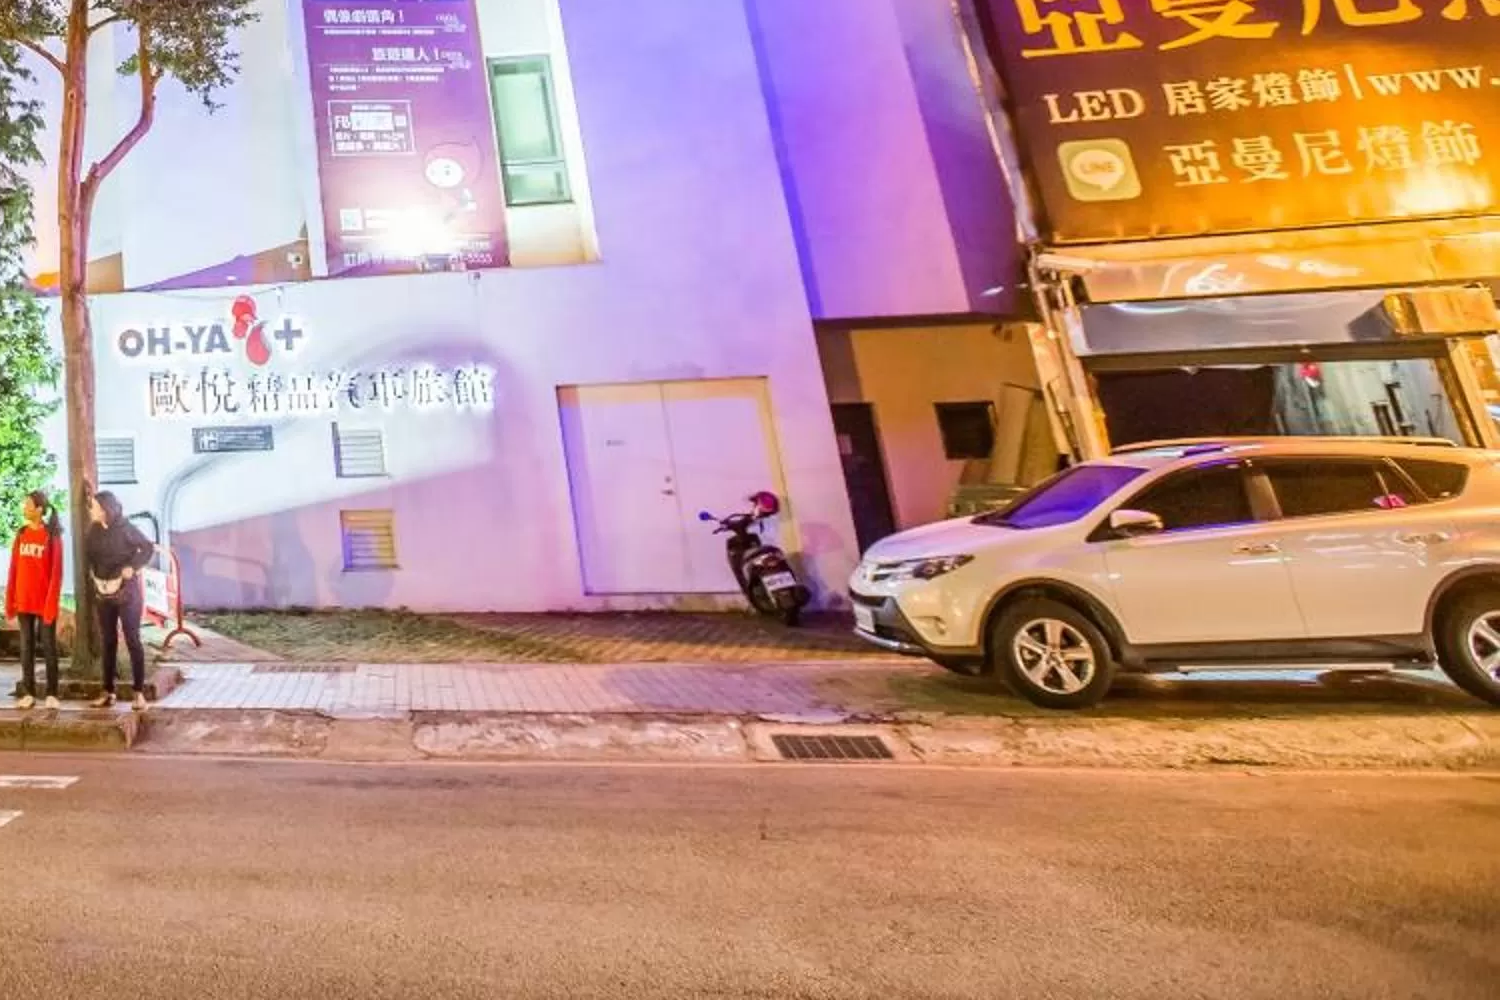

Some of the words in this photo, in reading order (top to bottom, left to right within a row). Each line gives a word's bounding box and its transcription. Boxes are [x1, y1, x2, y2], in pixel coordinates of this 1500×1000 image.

[1043, 88, 1145, 125] LED
[1162, 69, 1343, 117] 居家燈飾
[1164, 119, 1483, 188] 亞曼尼燈飾
[119, 323, 232, 357] OH-YA
[149, 365, 490, 415] 歐悅精品汽車旅館
